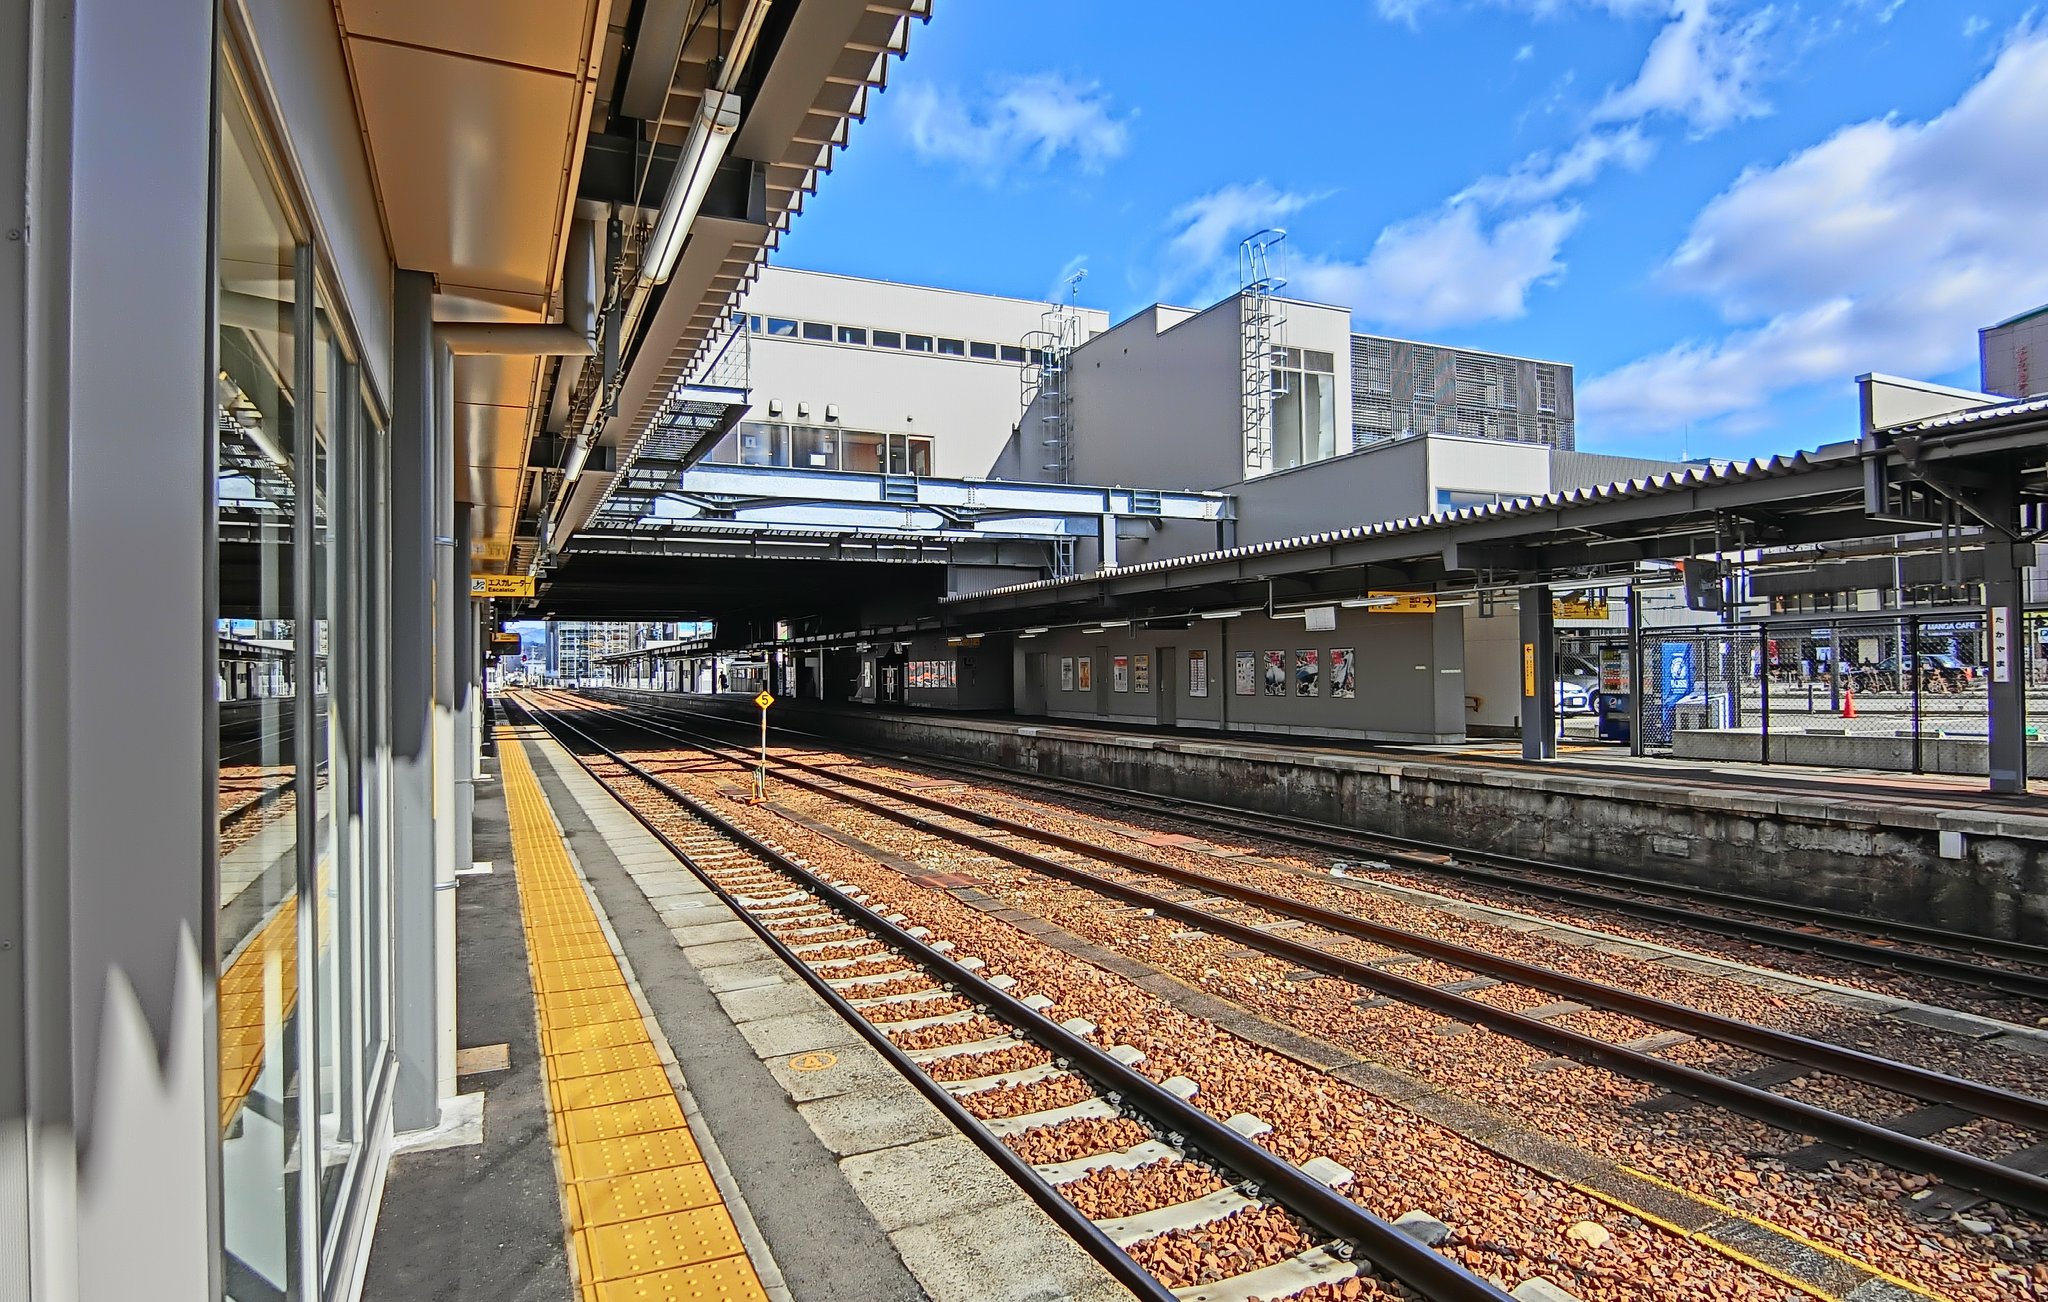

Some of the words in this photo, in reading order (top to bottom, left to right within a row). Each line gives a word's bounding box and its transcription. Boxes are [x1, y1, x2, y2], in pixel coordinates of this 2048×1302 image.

[488, 579, 531, 587] エスカレーター
[1955, 621, 1976, 629] CAFE
[1995, 617, 2005, 668] たかやま
[761, 694, 769, 706] 5
